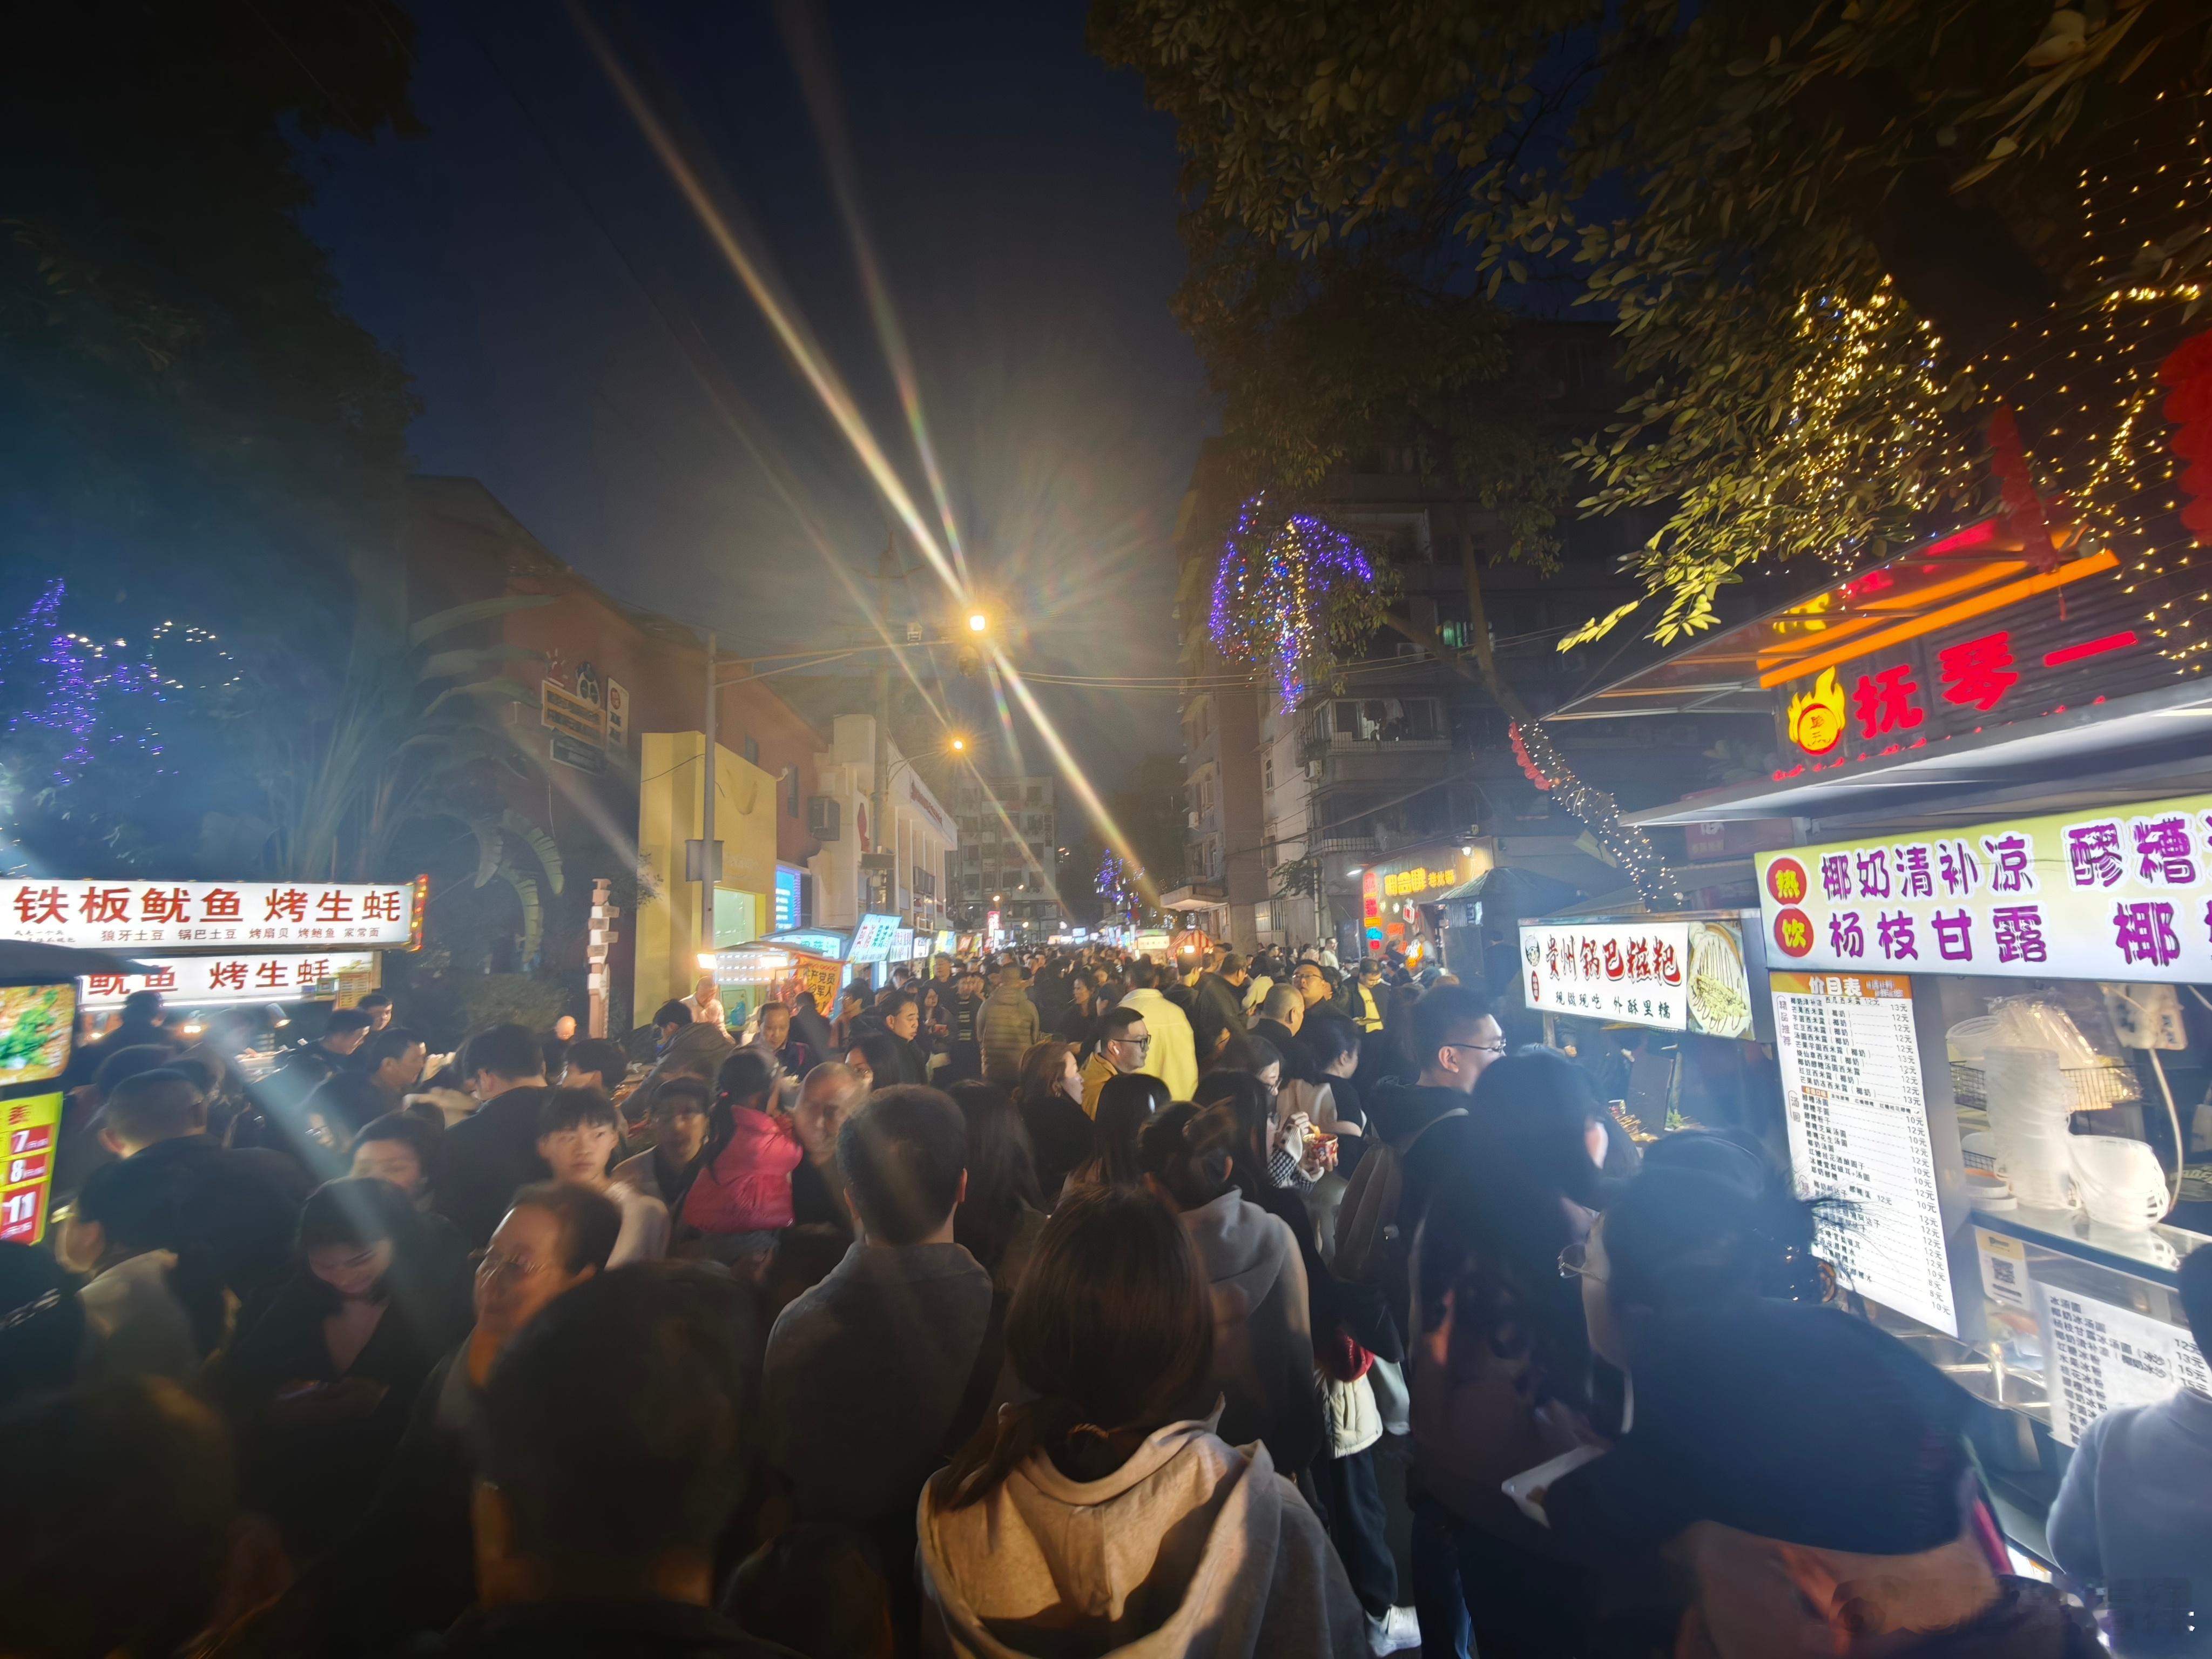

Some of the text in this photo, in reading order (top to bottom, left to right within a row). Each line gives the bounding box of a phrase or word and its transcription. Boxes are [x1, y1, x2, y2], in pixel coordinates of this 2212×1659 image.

[1820, 816, 2212, 900] 椰奶清补凉 醪糟
[14, 886, 401, 925] 铁板鱿鱼 烤生蚝
[101, 927, 380, 942] 狼牙土豆 锅巴土豆 烤扇贝 烤鲍鱼 家常面
[1829, 905, 2048, 965] 杨枝甘露
[209, 958, 330, 990] 烤生蚝
[1809, 976, 1863, 997] 价目表
[1891, 1004, 1907, 1013] 13元
[1779, 1000, 1792, 1047] 精品推荐
[1892, 1014, 1909, 1023] 12元
[1893, 1024, 1911, 1033] 12元
[1895, 1034, 1912, 1043] 12元
[1897, 1044, 1913, 1054] 12元
[1901, 1075, 1918, 1085] 12元
[1903, 1085, 1919, 1096] 12元
[1903, 1096, 1921, 1106] 13元
[1906, 1116, 1924, 1127] 10元
[1907, 1126, 1925, 1137] 12元
[12, 1130, 31, 1154] 7
[1908, 1136, 1927, 1147] 10元
[1910, 1146, 1928, 1158] 12元
[1912, 1156, 1930, 1168] 12元
[10, 1159, 25, 1183] 8
[1913, 1166, 1931, 1178] 10元
[1914, 1177, 1932, 1189] 10元
[1877, 1195, 1892, 1206] 12元
[1916, 1189, 1936, 1201] 12元
[2, 1191, 37, 1224] 11
[1917, 1201, 1937, 1213] 10元
[1921, 1225, 1940, 1238] 12元
[1923, 1236, 1941, 1249] 12元
[1924, 1247, 1943, 1260] 12元
[1926, 1258, 1944, 1271] 12元
[1927, 1269, 1946, 1282] 10元
[1932, 1301, 1951, 1316] 10元
